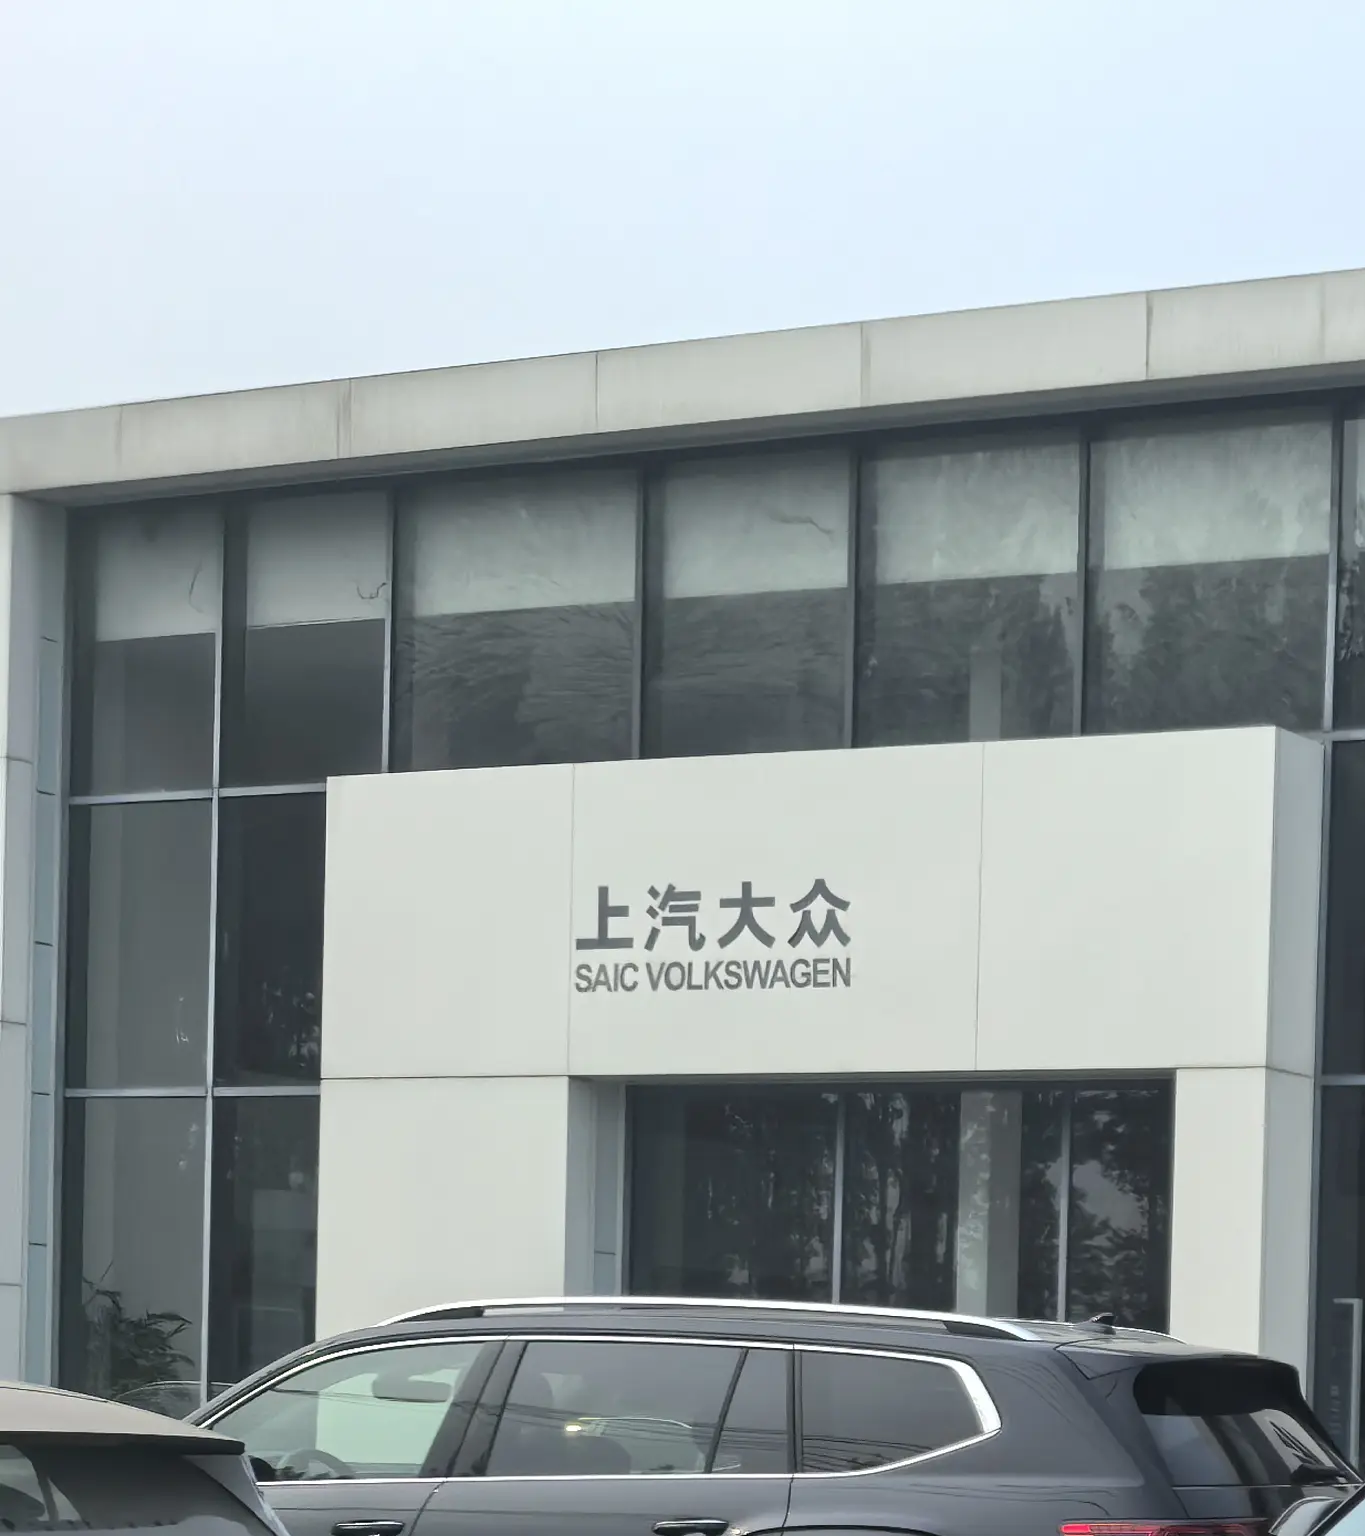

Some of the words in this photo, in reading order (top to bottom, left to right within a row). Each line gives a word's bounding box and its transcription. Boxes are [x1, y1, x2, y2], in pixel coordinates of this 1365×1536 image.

[575, 878, 852, 952] 上汽大众
[575, 962, 639, 993] SAIC
[645, 957, 852, 992] VOLKSWAGEN
